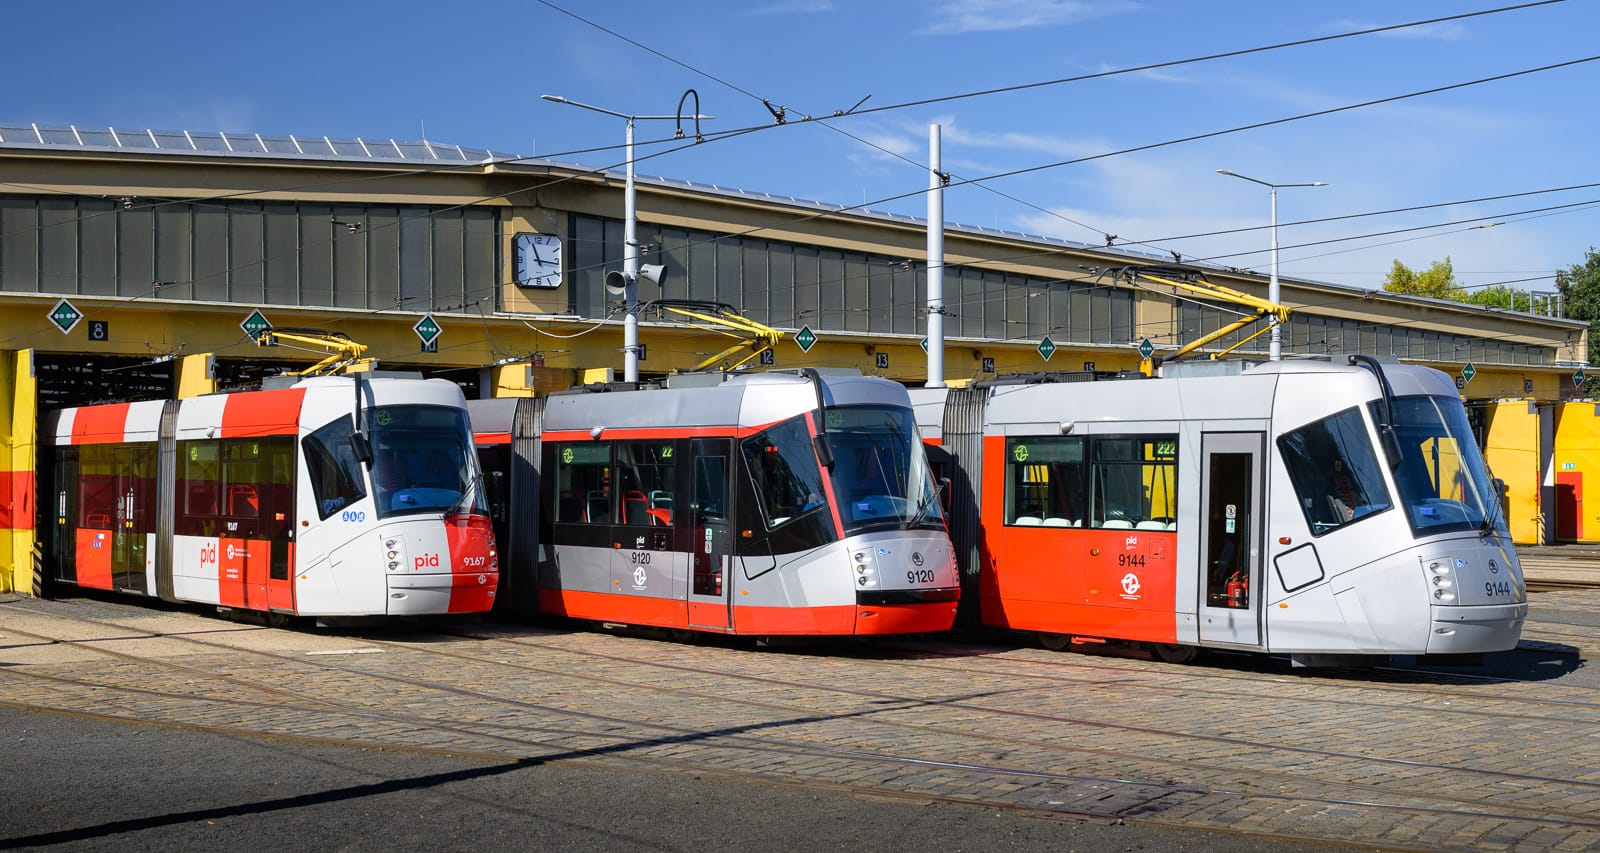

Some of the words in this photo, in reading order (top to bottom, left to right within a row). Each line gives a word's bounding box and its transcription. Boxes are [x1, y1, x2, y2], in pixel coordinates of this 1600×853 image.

[94, 322, 104, 338] 8
[762, 350, 773, 364] 12
[877, 354, 888, 368] 13
[984, 358, 994, 372] 14
[1086, 363, 1094, 372] 15
[1157, 442, 1176, 454] 222
[637, 536, 646, 544] pid
[1126, 536, 1136, 546] pid
[200, 542, 216, 568] pid
[414, 553, 440, 570] pid
[464, 556, 484, 566] 9167
[632, 552, 651, 564] 9120
[1118, 554, 1146, 568] 9144
[908, 570, 934, 584] 9120
[1485, 582, 1511, 596] 9144
